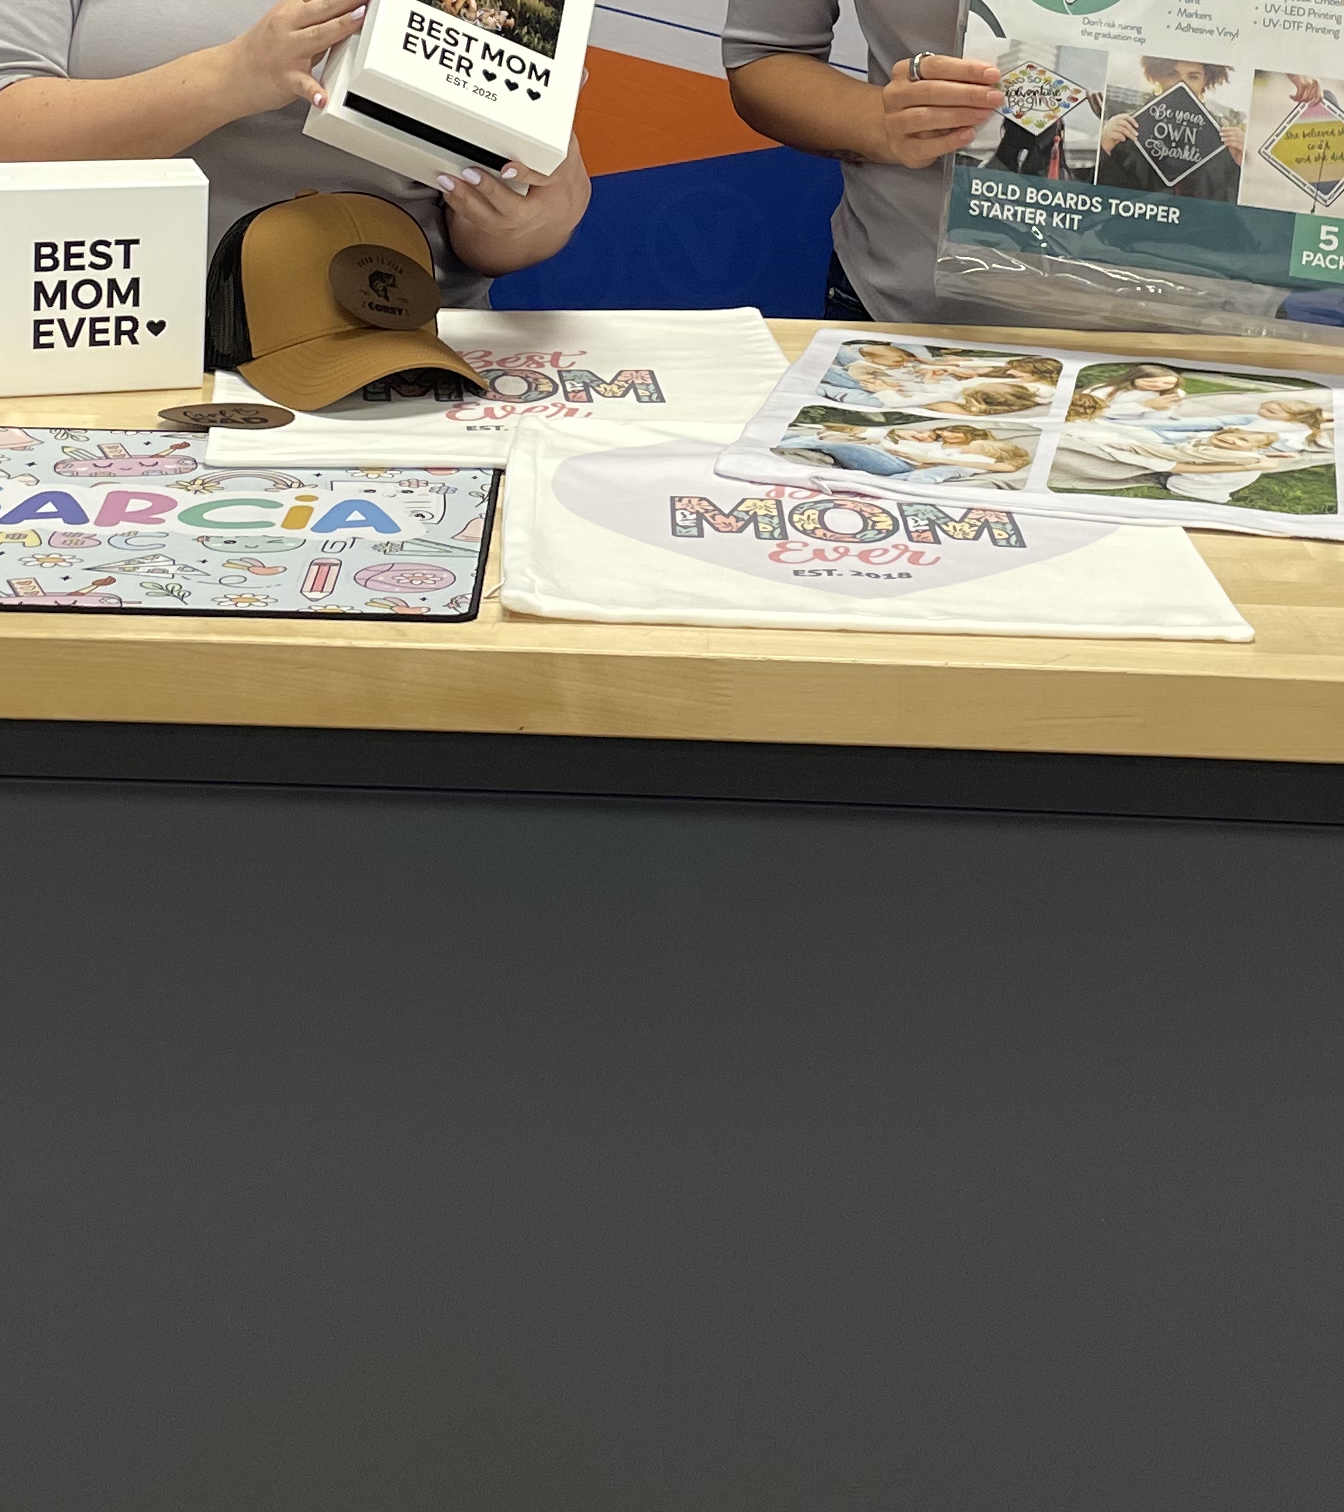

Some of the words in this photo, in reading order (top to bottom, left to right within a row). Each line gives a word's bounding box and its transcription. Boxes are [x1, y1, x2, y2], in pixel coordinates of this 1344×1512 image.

[1082, 17, 1103, 27] Don't
[1176, 8, 1213, 22] Markers
[1264, 4, 1306, 18] UV-LED
[1307, 8, 1343, 25] Printing
[1080, 28, 1094, 37] the
[1094, 30, 1133, 42] graduation
[1132, 35, 1147, 45] cap
[1174, 22, 1215, 37] Adhesive
[1216, 27, 1240, 42] Vinyl
[1262, 18, 1304, 32] UV-DTF
[1305, 23, 1341, 40] Printing
[402, 31, 474, 77] EVER
[407, 9, 479, 54] BEST
[480, 41, 552, 88] MOM
[446, 73, 470, 92] EST.
[471, 84, 498, 103] 2025
[1149, 103, 1174, 121] Be
[1175, 109, 1207, 127] your
[1153, 121, 1198, 145] OWN
[968, 199, 1047, 227] STARTER
[1051, 211, 1083, 231] KIT
[970, 178, 1020, 201] BOLD
[1024, 187, 1102, 213] BOARDS
[1108, 197, 1181, 225] TOPPER
[1318, 224, 1339, 251] 5
[33, 237, 141, 273] BEST
[33, 276, 141, 312] MOM
[32, 315, 140, 350] EVER
[670, 495, 1027, 549] MOM
[767, 540, 942, 567] Ever
[792, 568, 844, 579] EST.
